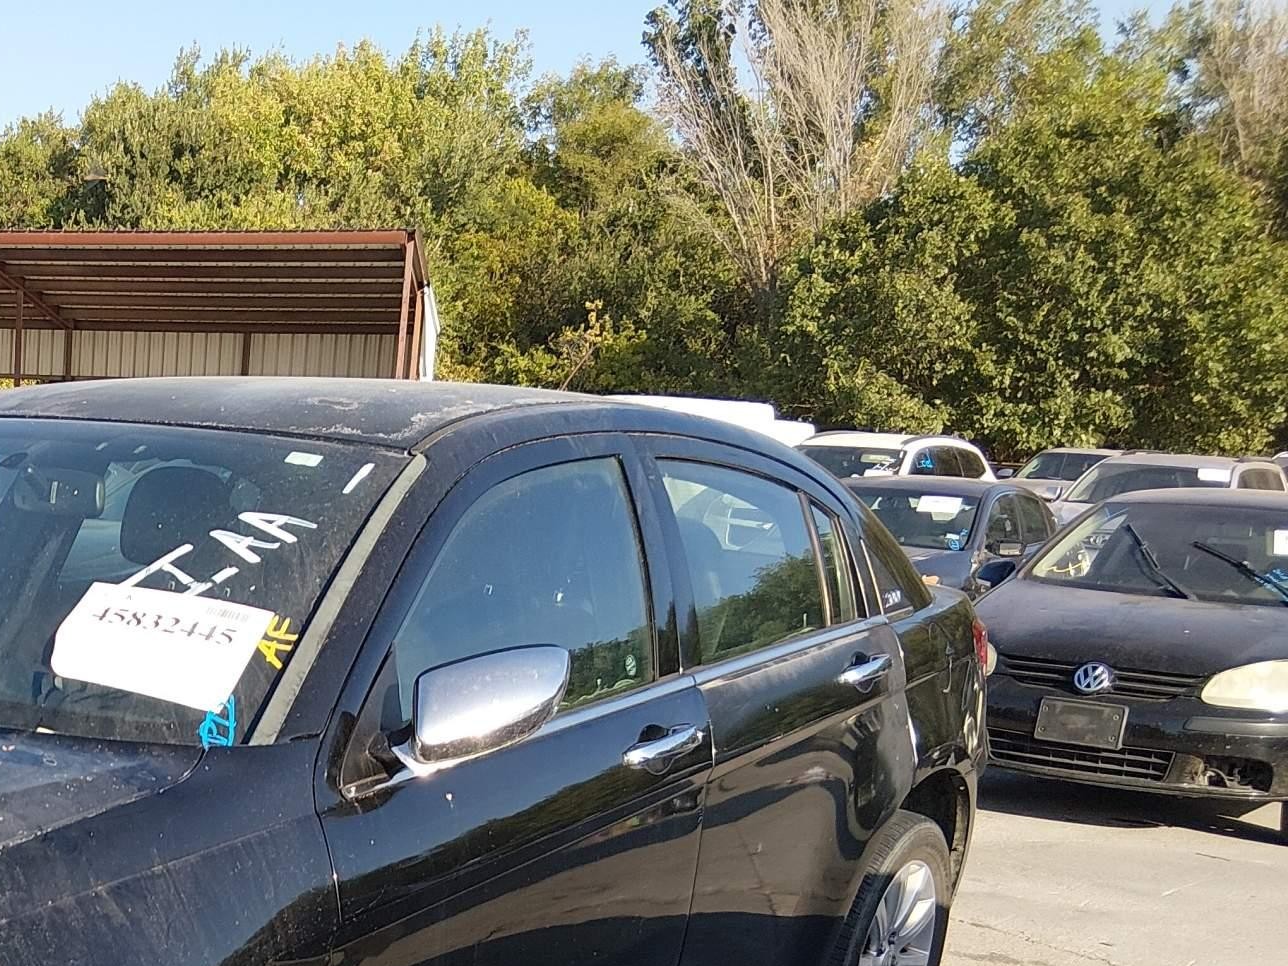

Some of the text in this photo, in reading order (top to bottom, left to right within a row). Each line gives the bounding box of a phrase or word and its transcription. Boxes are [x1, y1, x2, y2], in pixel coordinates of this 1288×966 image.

[92, 606, 237, 645] 45832445
[257, 614, 299, 670] AF
[1074, 662, 1110, 691] VW
